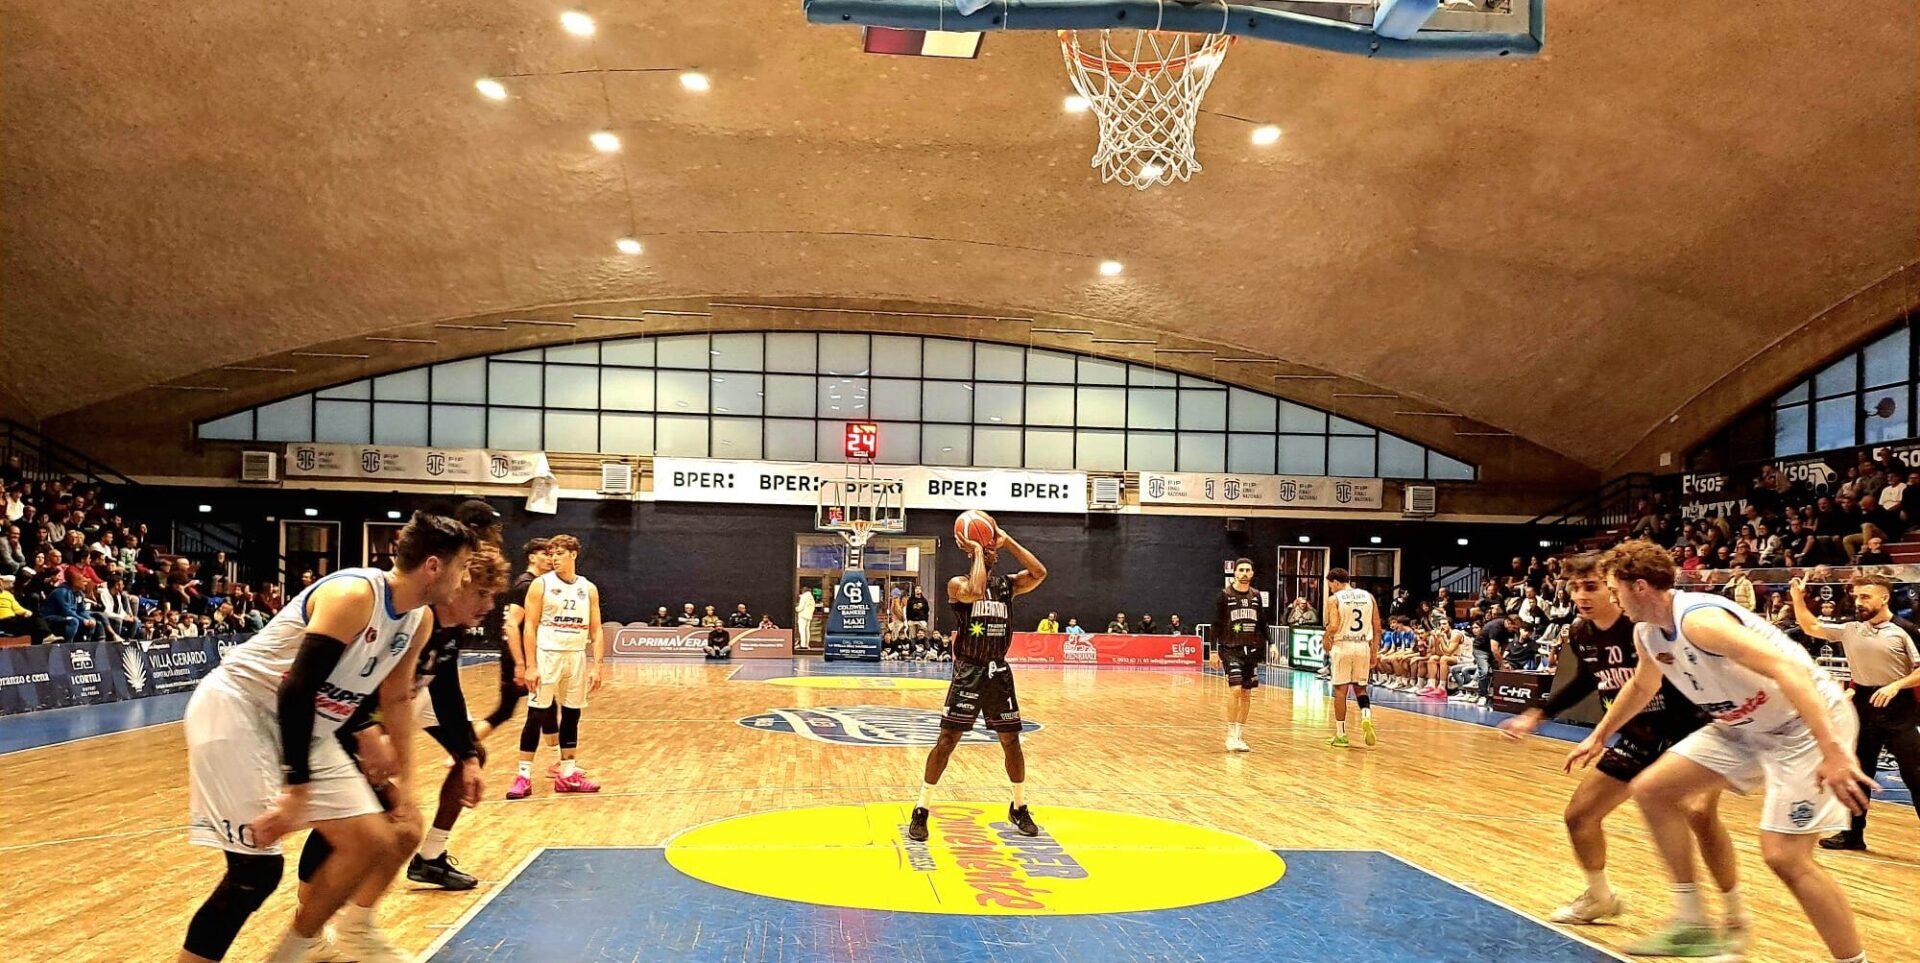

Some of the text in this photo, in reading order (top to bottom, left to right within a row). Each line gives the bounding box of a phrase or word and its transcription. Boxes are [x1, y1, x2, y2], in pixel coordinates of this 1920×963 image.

[848, 434, 875, 452] 24
[673, 472, 734, 488] BPER:
[928, 480, 987, 497] BPER:
[1011, 483, 1069, 499] BPER:
[563, 599, 577, 611] 22
[1350, 608, 1363, 632] 3
[149, 651, 207, 669] VILLA GERARDO
[31, 672, 50, 682] cena
